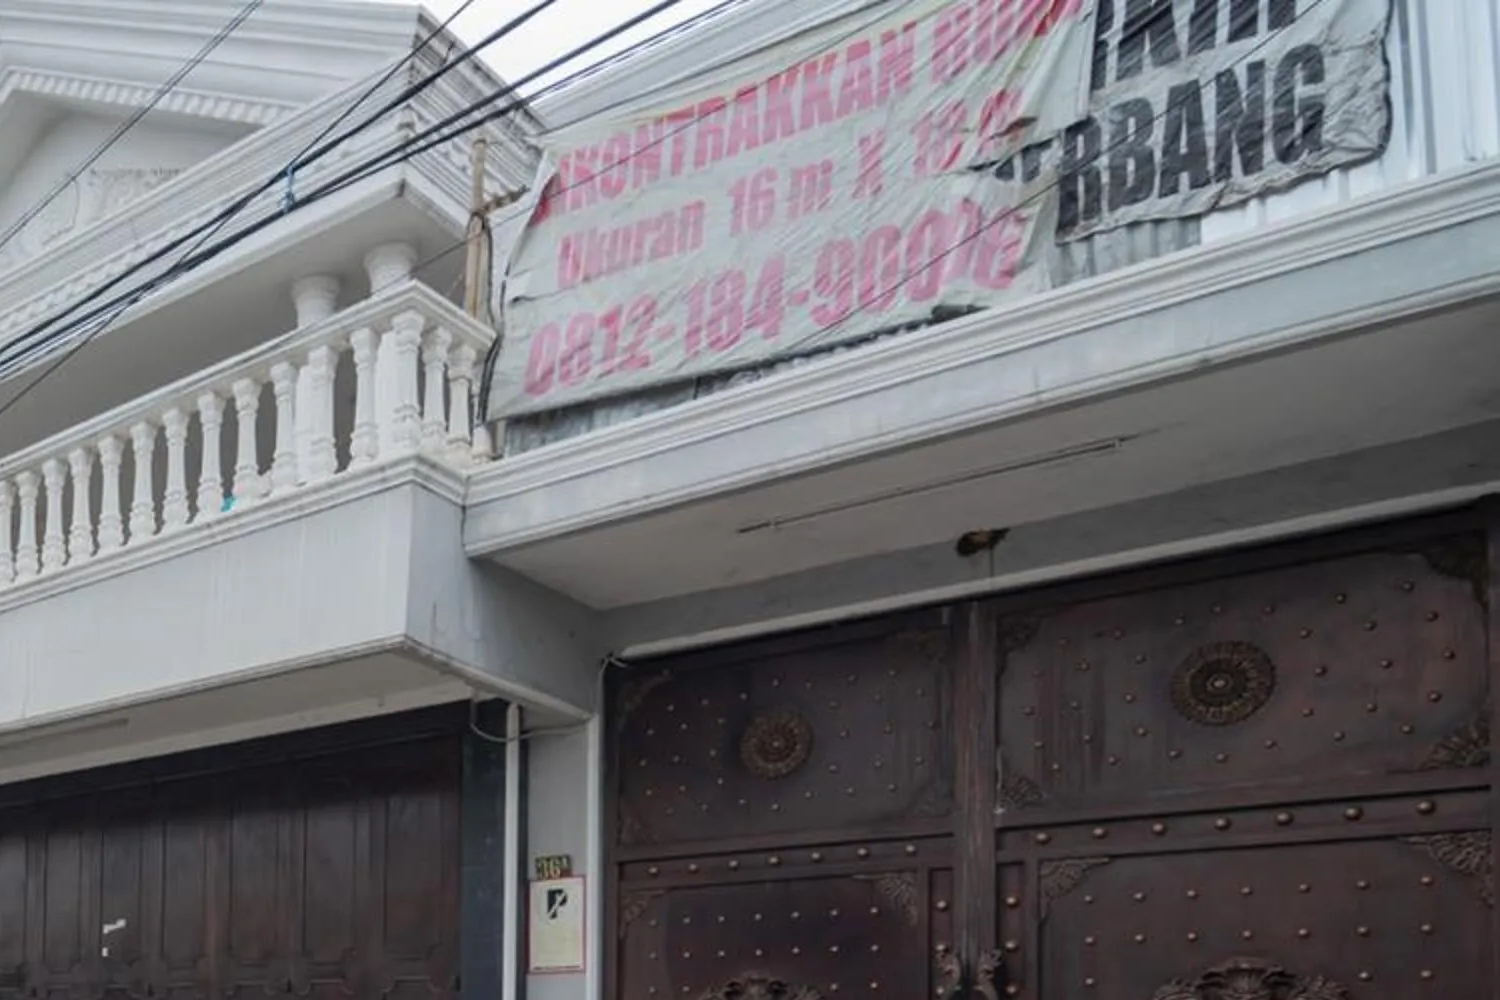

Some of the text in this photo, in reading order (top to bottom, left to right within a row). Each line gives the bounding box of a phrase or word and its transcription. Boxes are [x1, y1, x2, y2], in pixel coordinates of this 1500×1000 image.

[530, 21, 917, 226] IKONTRAKKAN
[557, 199, 706, 289] Ukuran
[728, 167, 778, 237] 16
